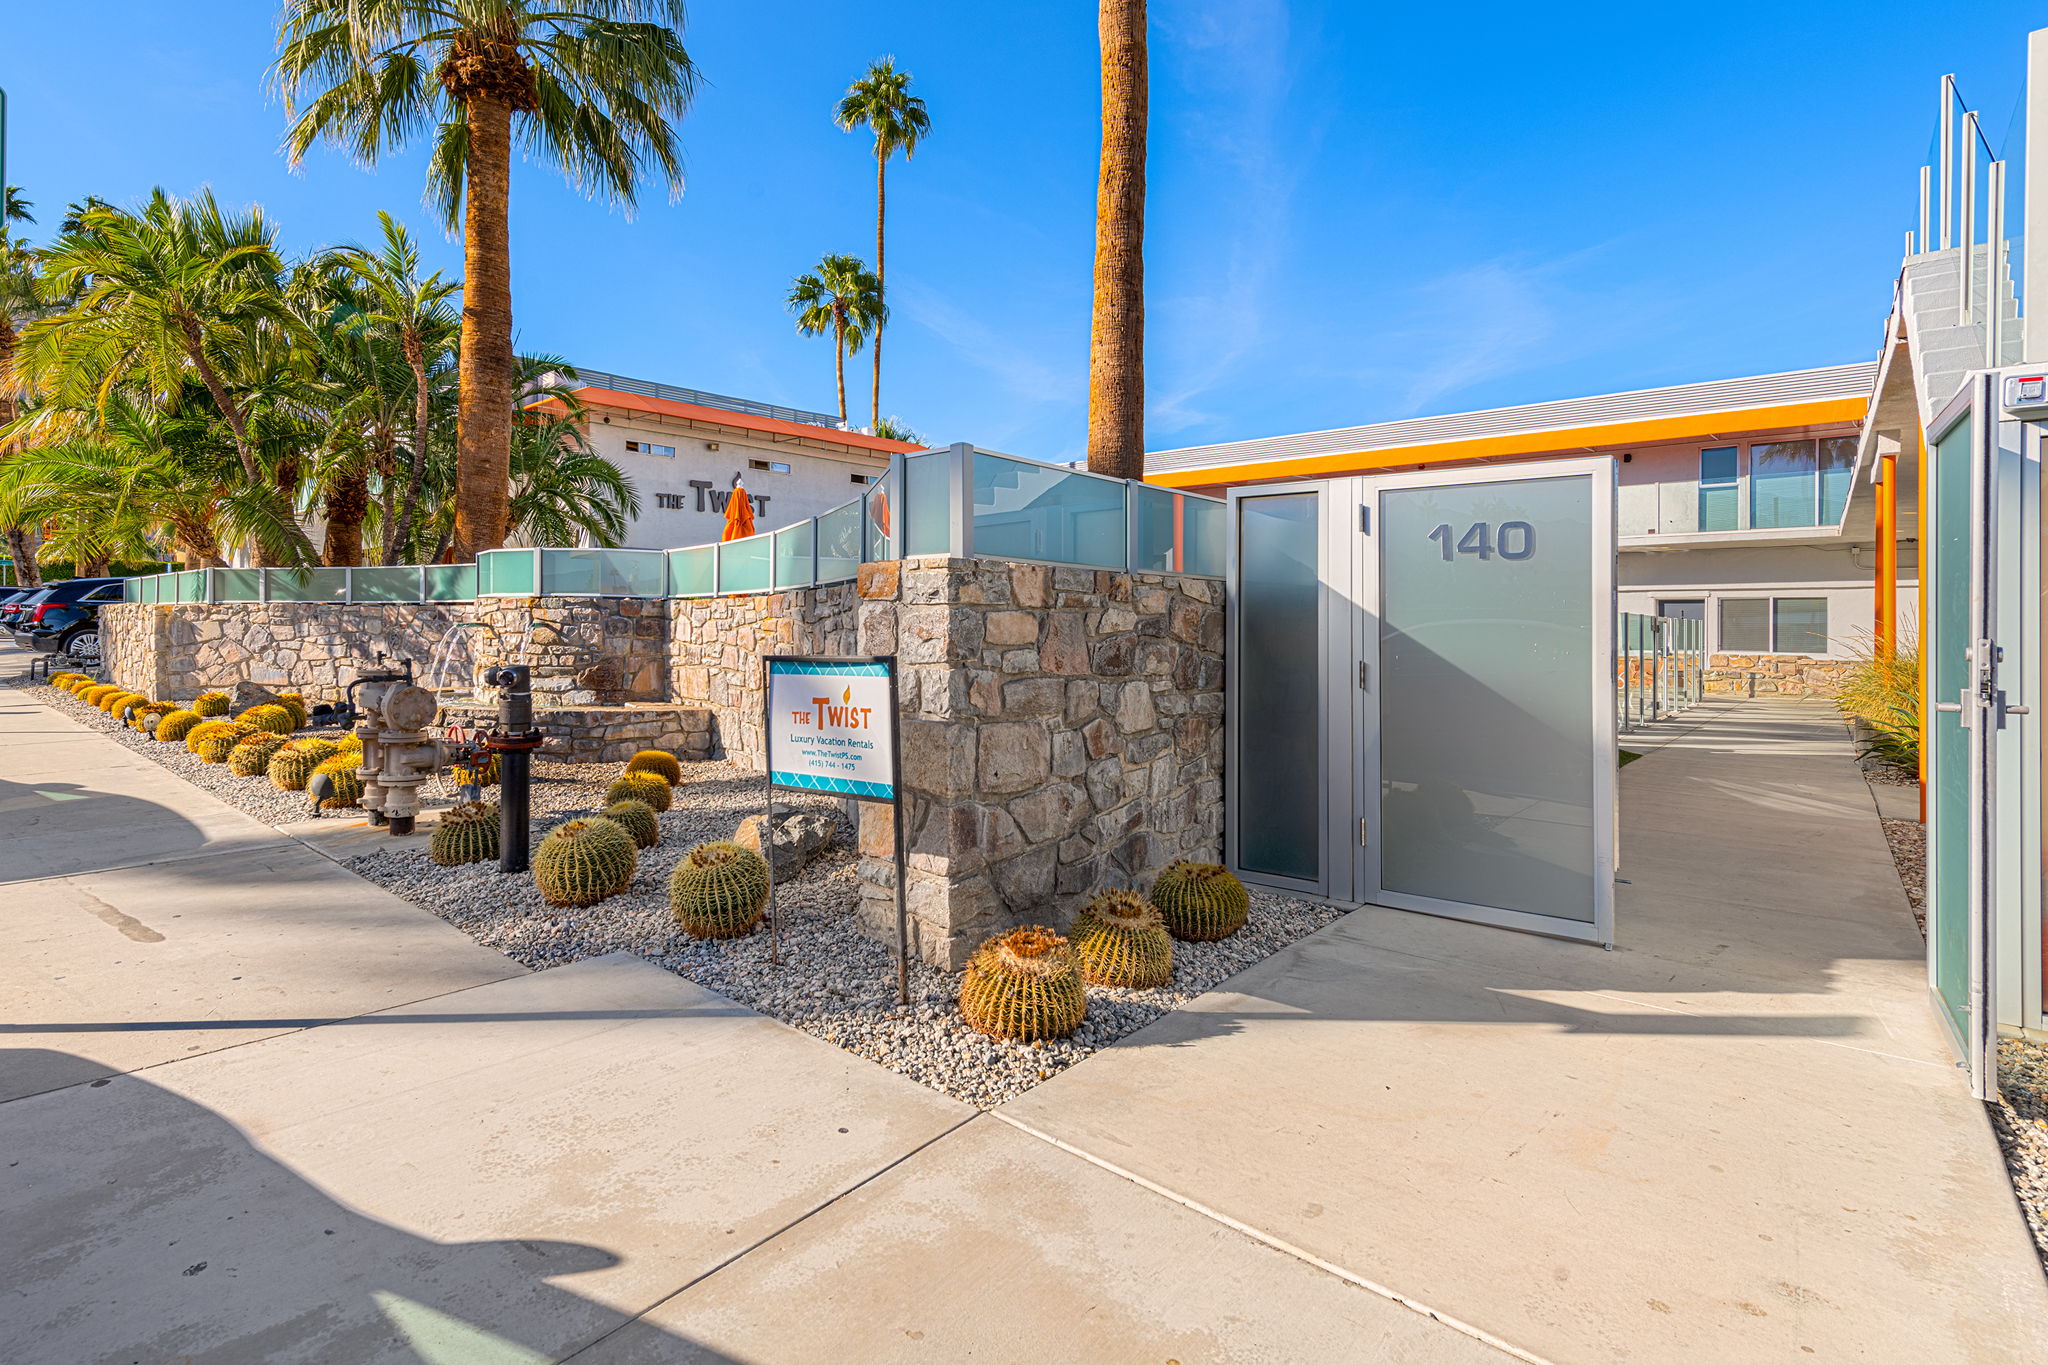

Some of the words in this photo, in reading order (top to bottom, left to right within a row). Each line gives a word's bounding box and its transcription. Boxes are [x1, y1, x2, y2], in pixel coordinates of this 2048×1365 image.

[655, 492, 685, 510] THE
[1426, 520, 1536, 561] 140
[791, 711, 812, 725] THE
[812, 697, 872, 730] TWIST
[790, 734, 815, 746] Luxury
[817, 736, 846, 747] Vacation
[847, 738, 874, 750] Rentals
[801, 749, 863, 761] www.TheTwistPS.com
[808, 759, 824, 768] (415)
[825, 760, 836, 768] 744
[841, 762, 856, 771] 1475
